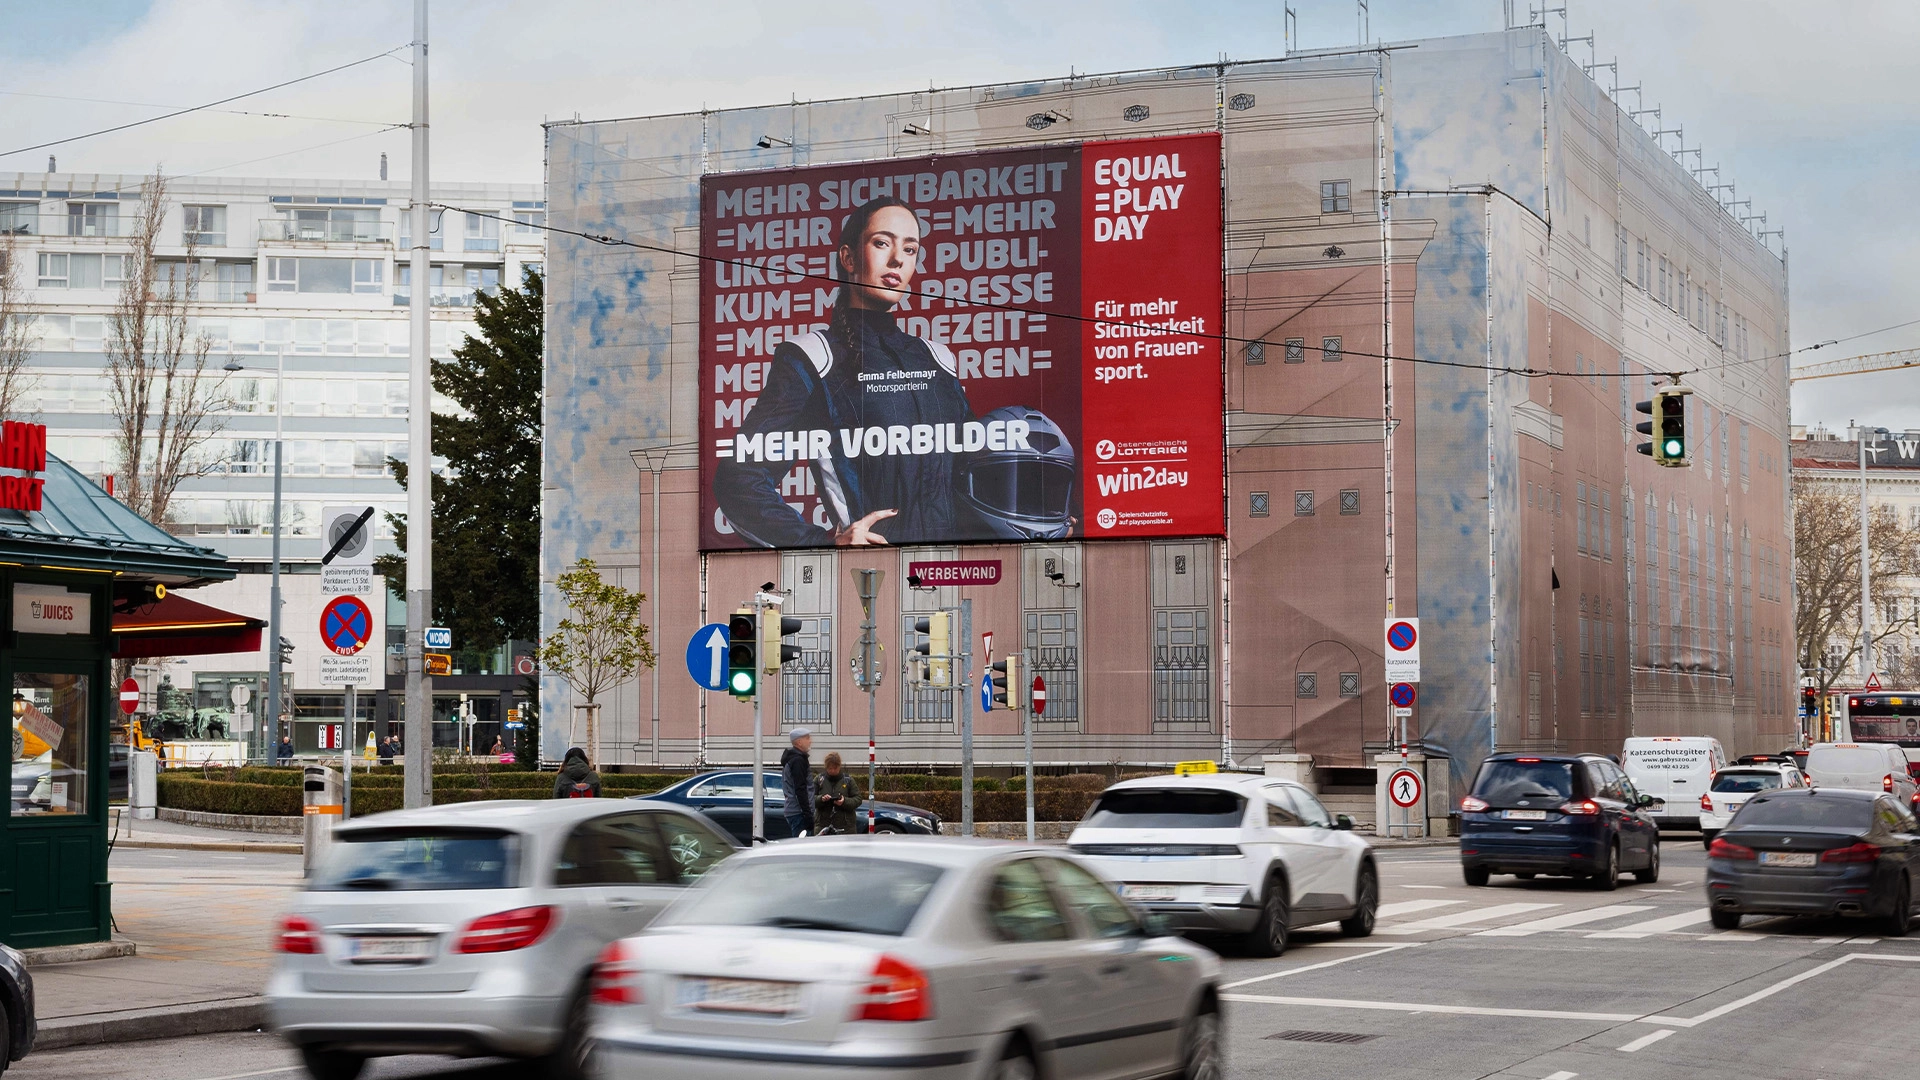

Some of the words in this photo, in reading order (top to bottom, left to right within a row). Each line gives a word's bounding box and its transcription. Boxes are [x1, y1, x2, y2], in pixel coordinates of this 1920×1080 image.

[1094, 153, 1187, 188] EQUAL
[716, 183, 811, 219] MEHR
[818, 162, 1068, 211] SICHTBARKEIT
[1094, 184, 1185, 214] =PLAY
[716, 217, 832, 252] =MEHR
[1094, 214, 1150, 243] DAY
[935, 237, 1049, 273] PUBLI-
[920, 272, 1053, 310] PRESSE
[1094, 299, 1125, 318] Für
[1130, 297, 1178, 317] mehr
[716, 322, 831, 357] =MEH
[896, 311, 1047, 344] DEZEIT=
[1094, 316, 1205, 339] Sichtbarkeit
[1094, 345, 1129, 360] von
[1134, 341, 1205, 358] Frauen-
[953, 346, 1052, 380] REN=
[1094, 363, 1149, 384] sport.
[857, 373, 885, 382] Emma
[886, 369, 937, 380] Felbermayr
[866, 381, 928, 393] Motorsportlerin
[0, 420, 47, 472] HN
[715, 429, 833, 464] =MEHR
[839, 420, 1031, 459] VORBILDER
[1117, 446, 1188, 456] LOTTERIEN
[0, 475, 45, 511] RKT
[1096, 466, 1188, 497] win2day
[1098, 514, 1116, 524] 18+
[1128, 518, 1173, 526] playsponsible.at
[914, 566, 996, 580] WERBEWAND
[42, 604, 74, 621] JUICES
[430, 632, 439, 644] WC
[335, 646, 356, 655] ENDE
[1629, 748, 1707, 757] Katzenschutzgitter
